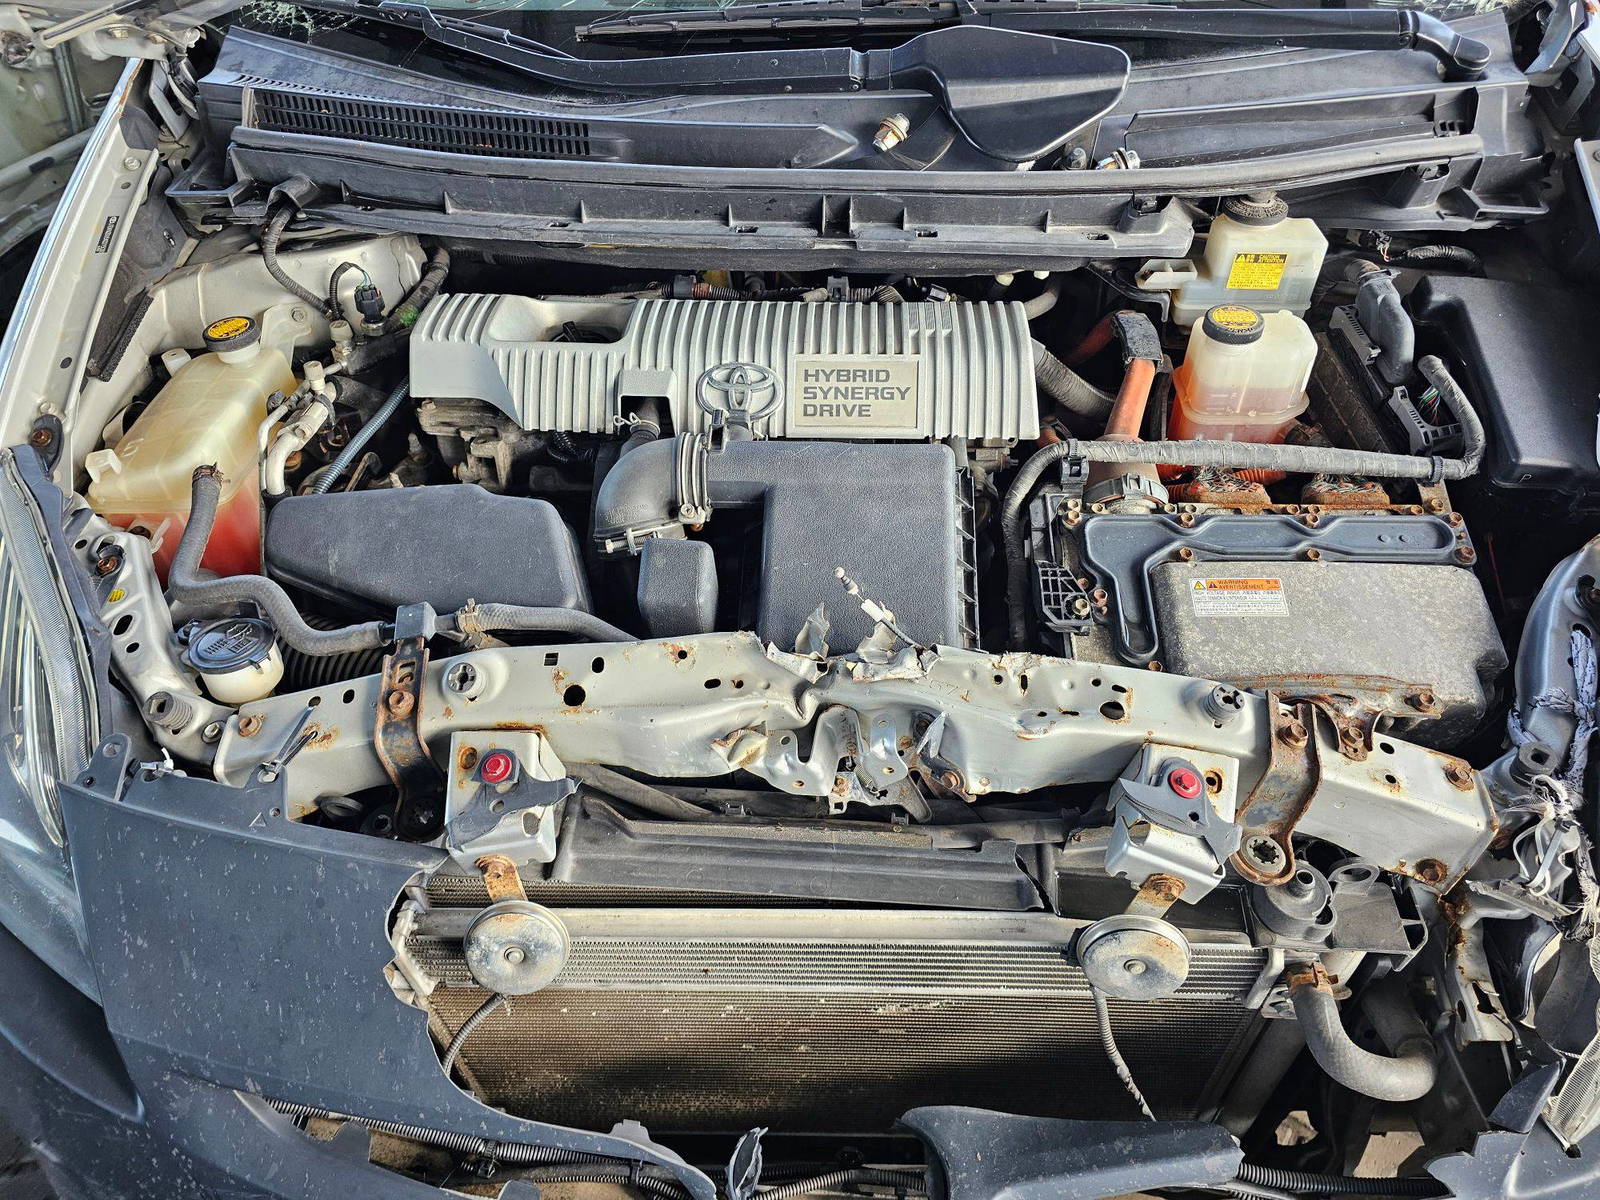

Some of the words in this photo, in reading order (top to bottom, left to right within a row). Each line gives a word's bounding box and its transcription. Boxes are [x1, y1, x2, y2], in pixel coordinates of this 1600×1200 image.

[804, 369, 890, 382] HYBRID
[803, 386, 911, 400] SYNERGY
[803, 403, 872, 417] DRIVE
